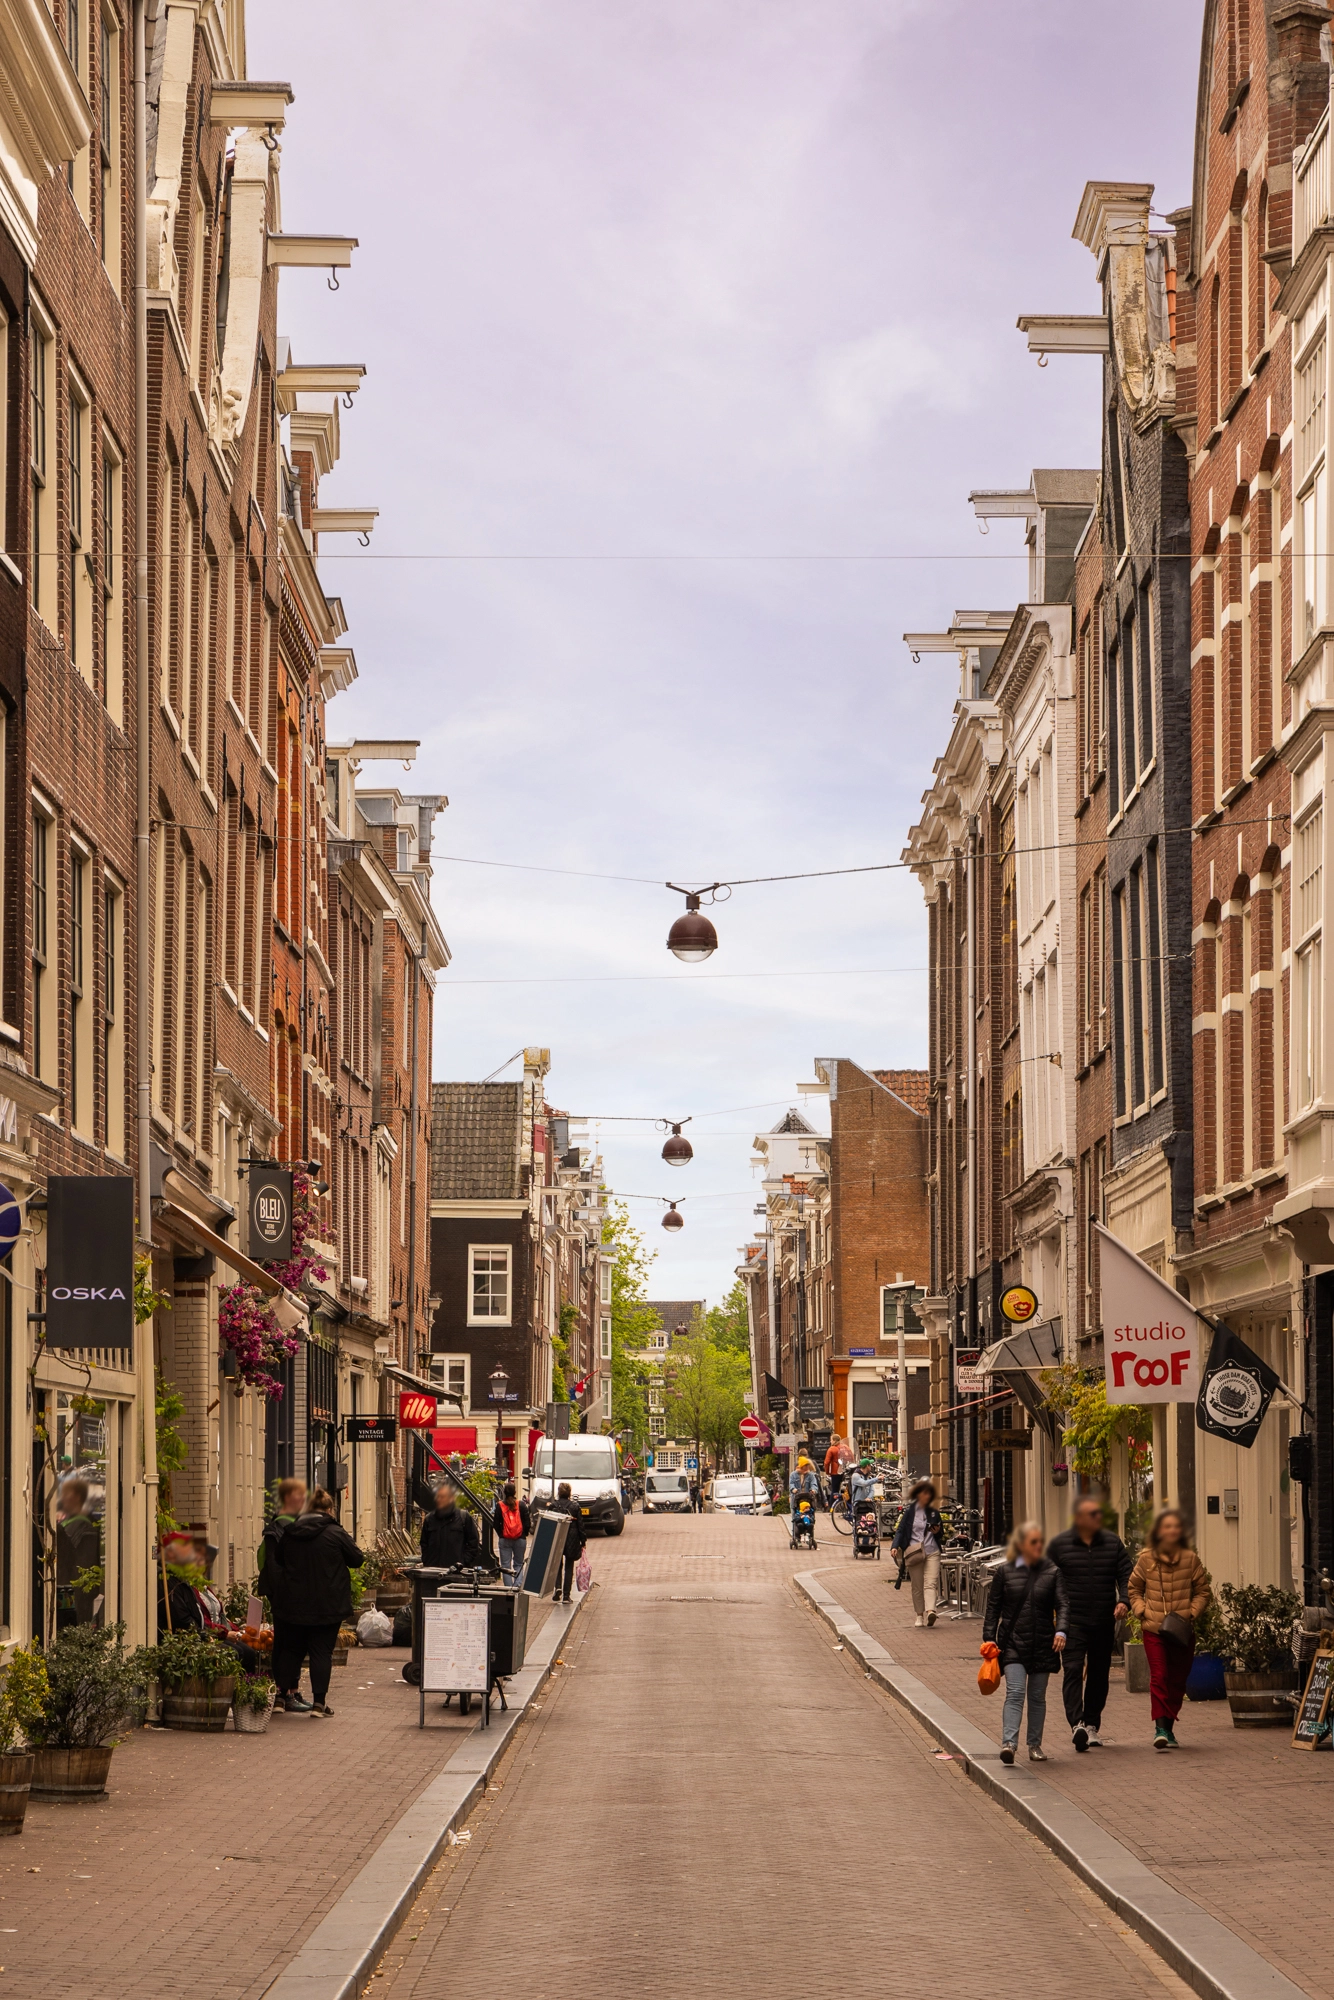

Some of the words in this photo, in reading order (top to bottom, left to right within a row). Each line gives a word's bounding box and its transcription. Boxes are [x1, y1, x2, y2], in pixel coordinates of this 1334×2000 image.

[259, 1197, 281, 1220] BLEU
[52, 1287, 126, 1300] OSKA
[1114, 1321, 1186, 1342] studio
[1216, 1372, 1230, 1383] THOSE
[1230, 1371, 1241, 1379] DAM
[1240, 1374, 1252, 1385] BOAT
[403, 1398, 435, 1424] illy
